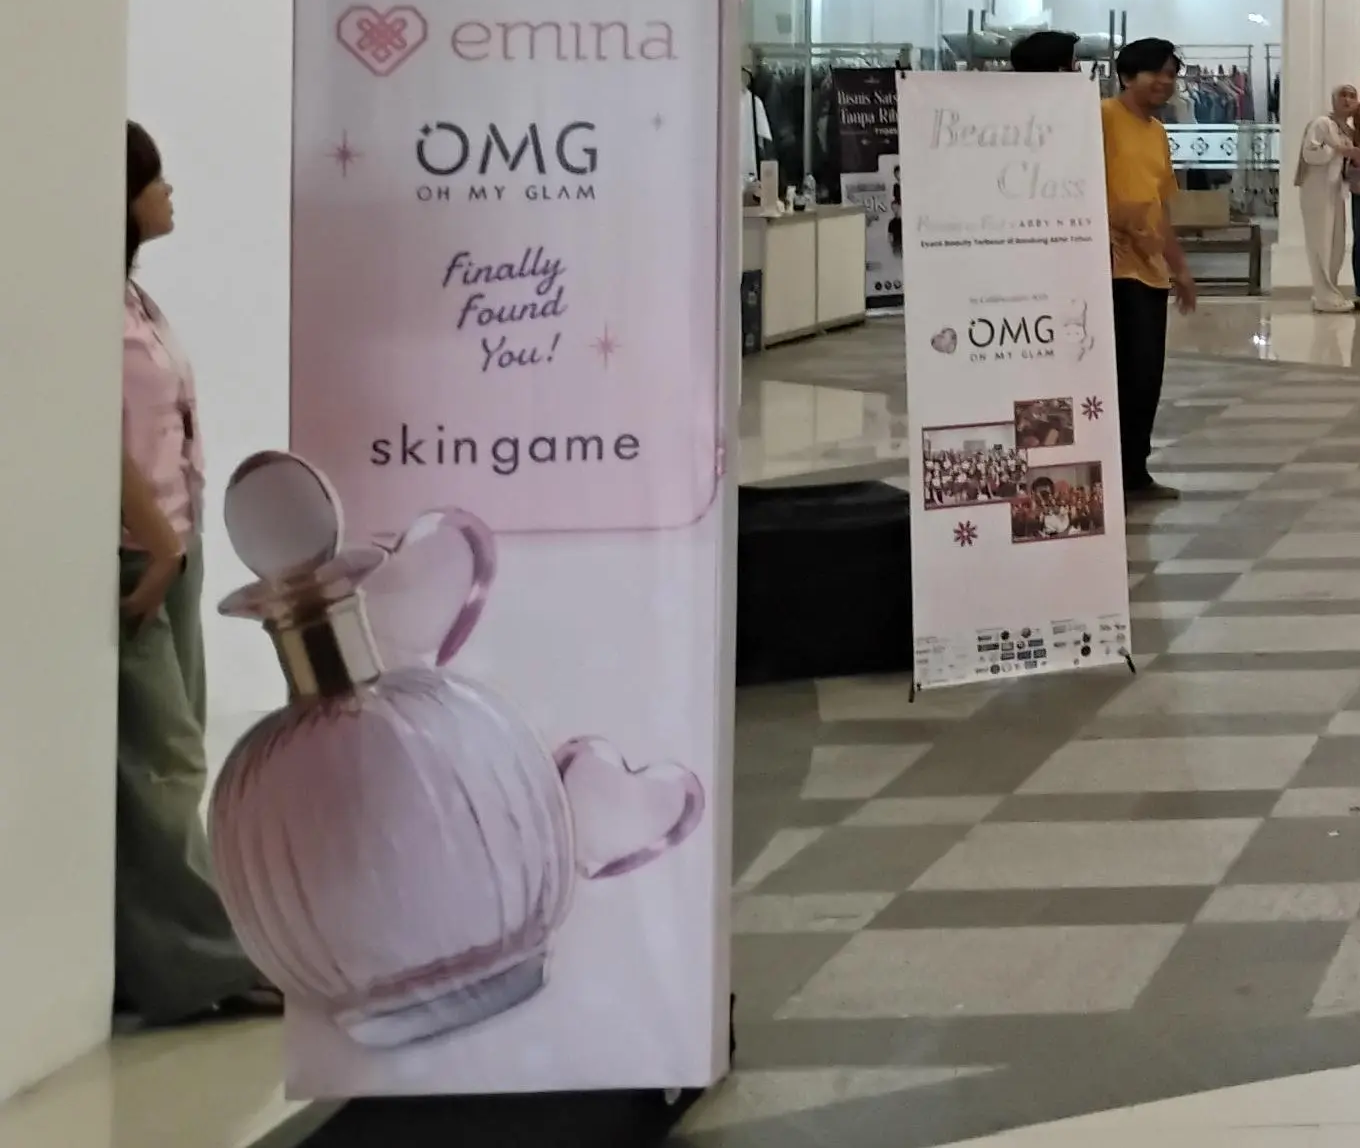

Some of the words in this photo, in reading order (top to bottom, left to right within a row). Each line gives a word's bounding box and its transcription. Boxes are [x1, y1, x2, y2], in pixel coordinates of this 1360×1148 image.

[415, 121, 598, 177] OMG
[416, 185, 451, 202] OH
[468, 185, 505, 202] MY
[525, 184, 597, 201] GLAM
[968, 314, 1055, 348] OMG
[479, 332, 561, 374] You!
[371, 424, 641, 475] skingame
